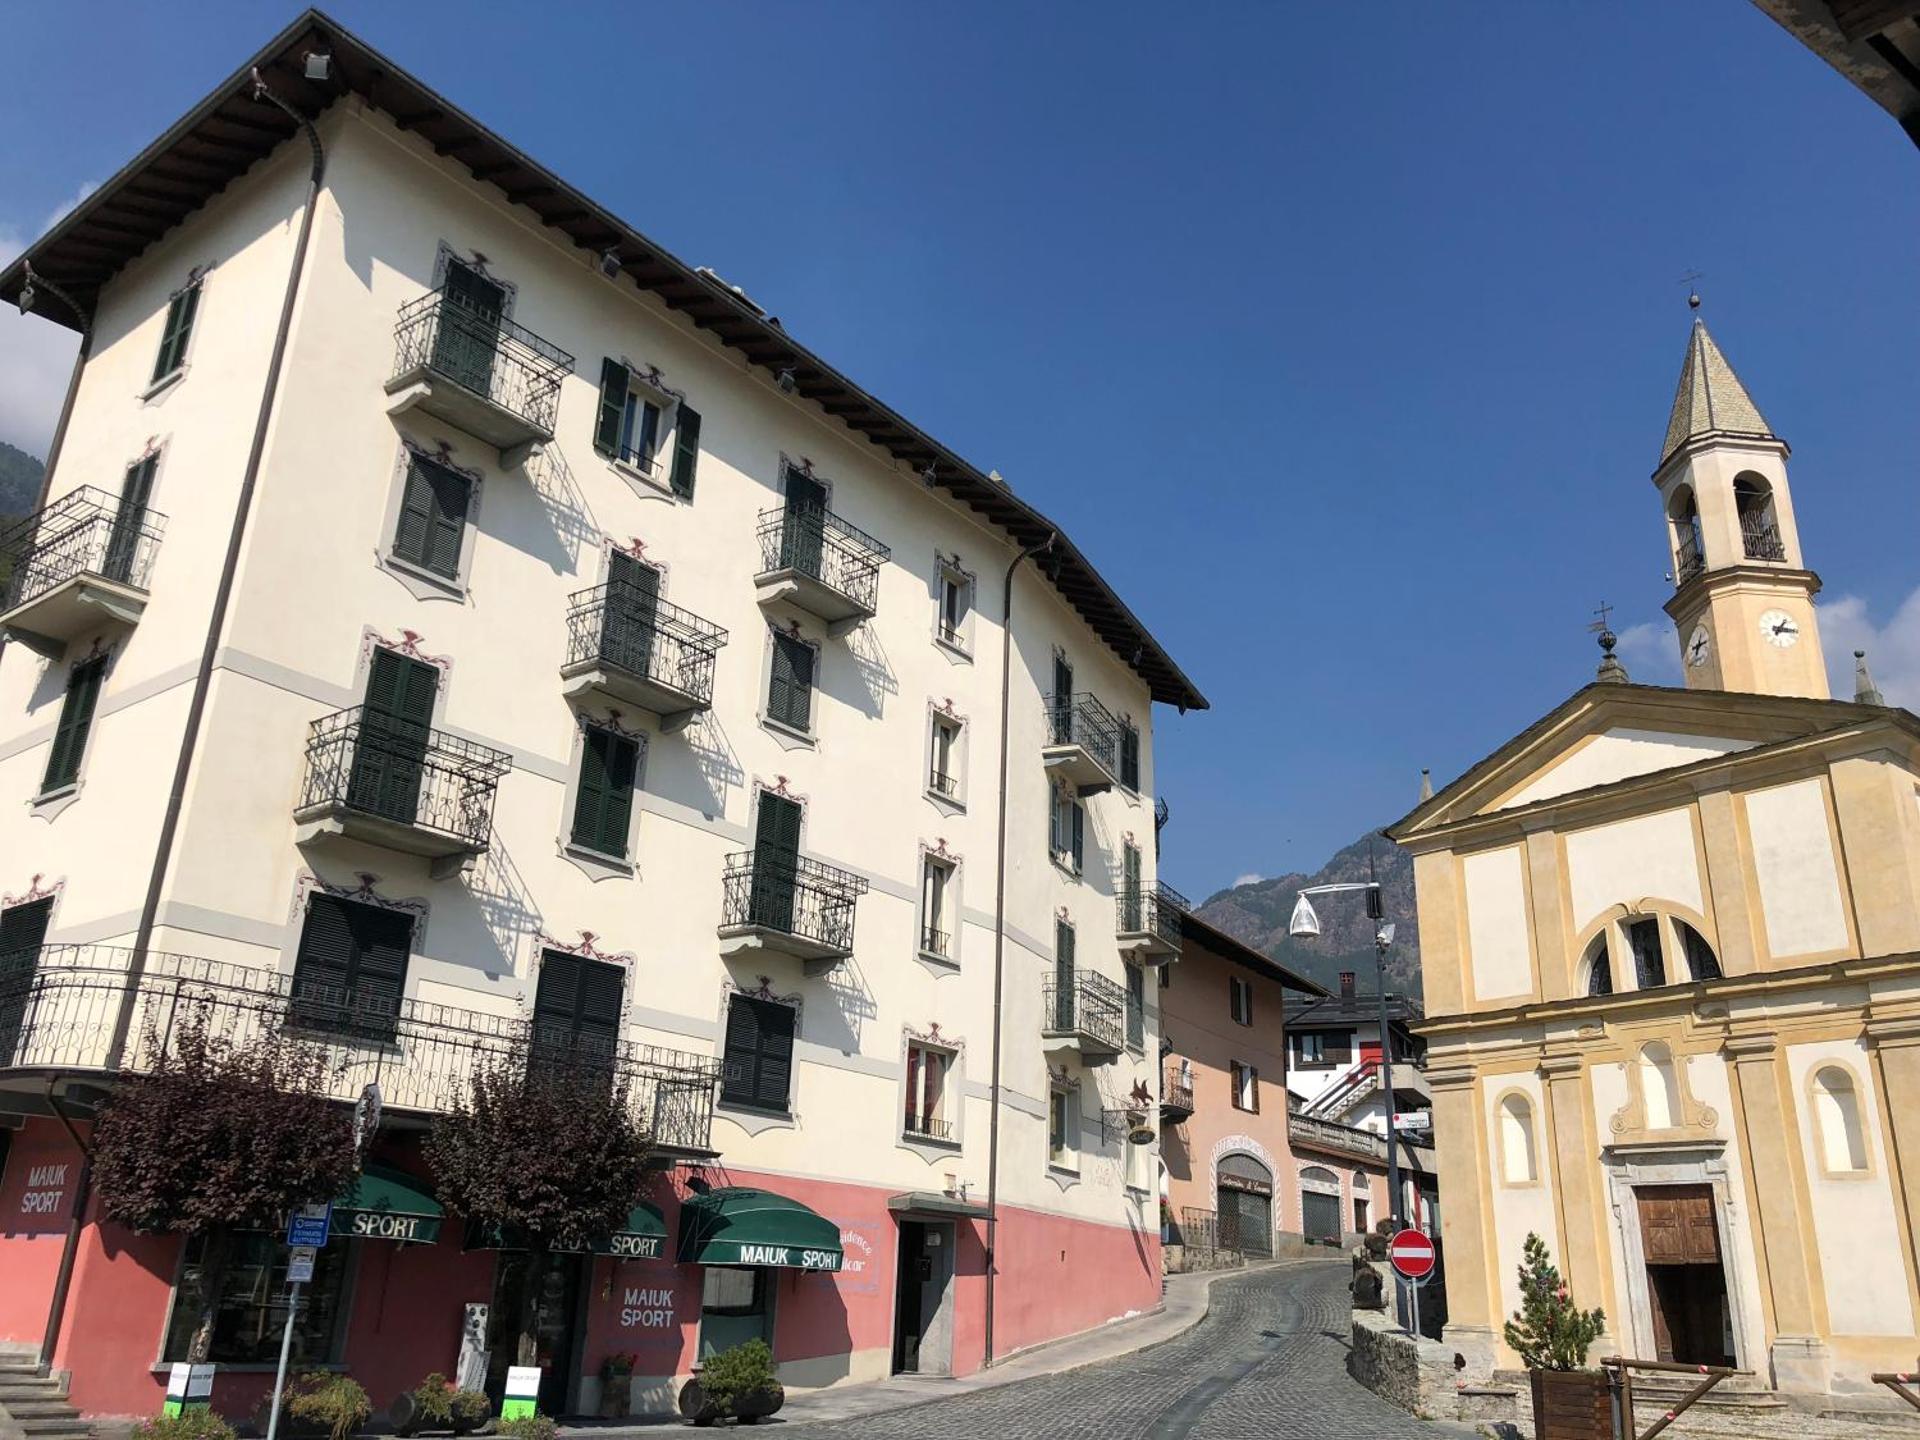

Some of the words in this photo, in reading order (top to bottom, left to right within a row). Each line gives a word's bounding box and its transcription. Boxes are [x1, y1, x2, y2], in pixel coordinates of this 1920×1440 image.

[28, 1164, 68, 1187] MAIUK
[21, 1191, 63, 1213] SPORT
[352, 1213, 419, 1238] SPORT
[610, 1234, 659, 1256] SPORT
[740, 1245, 789, 1265] MAIUK
[802, 1250, 838, 1269] SPORT
[624, 1288, 674, 1307] MAIUK
[620, 1308, 674, 1328] SPORT
